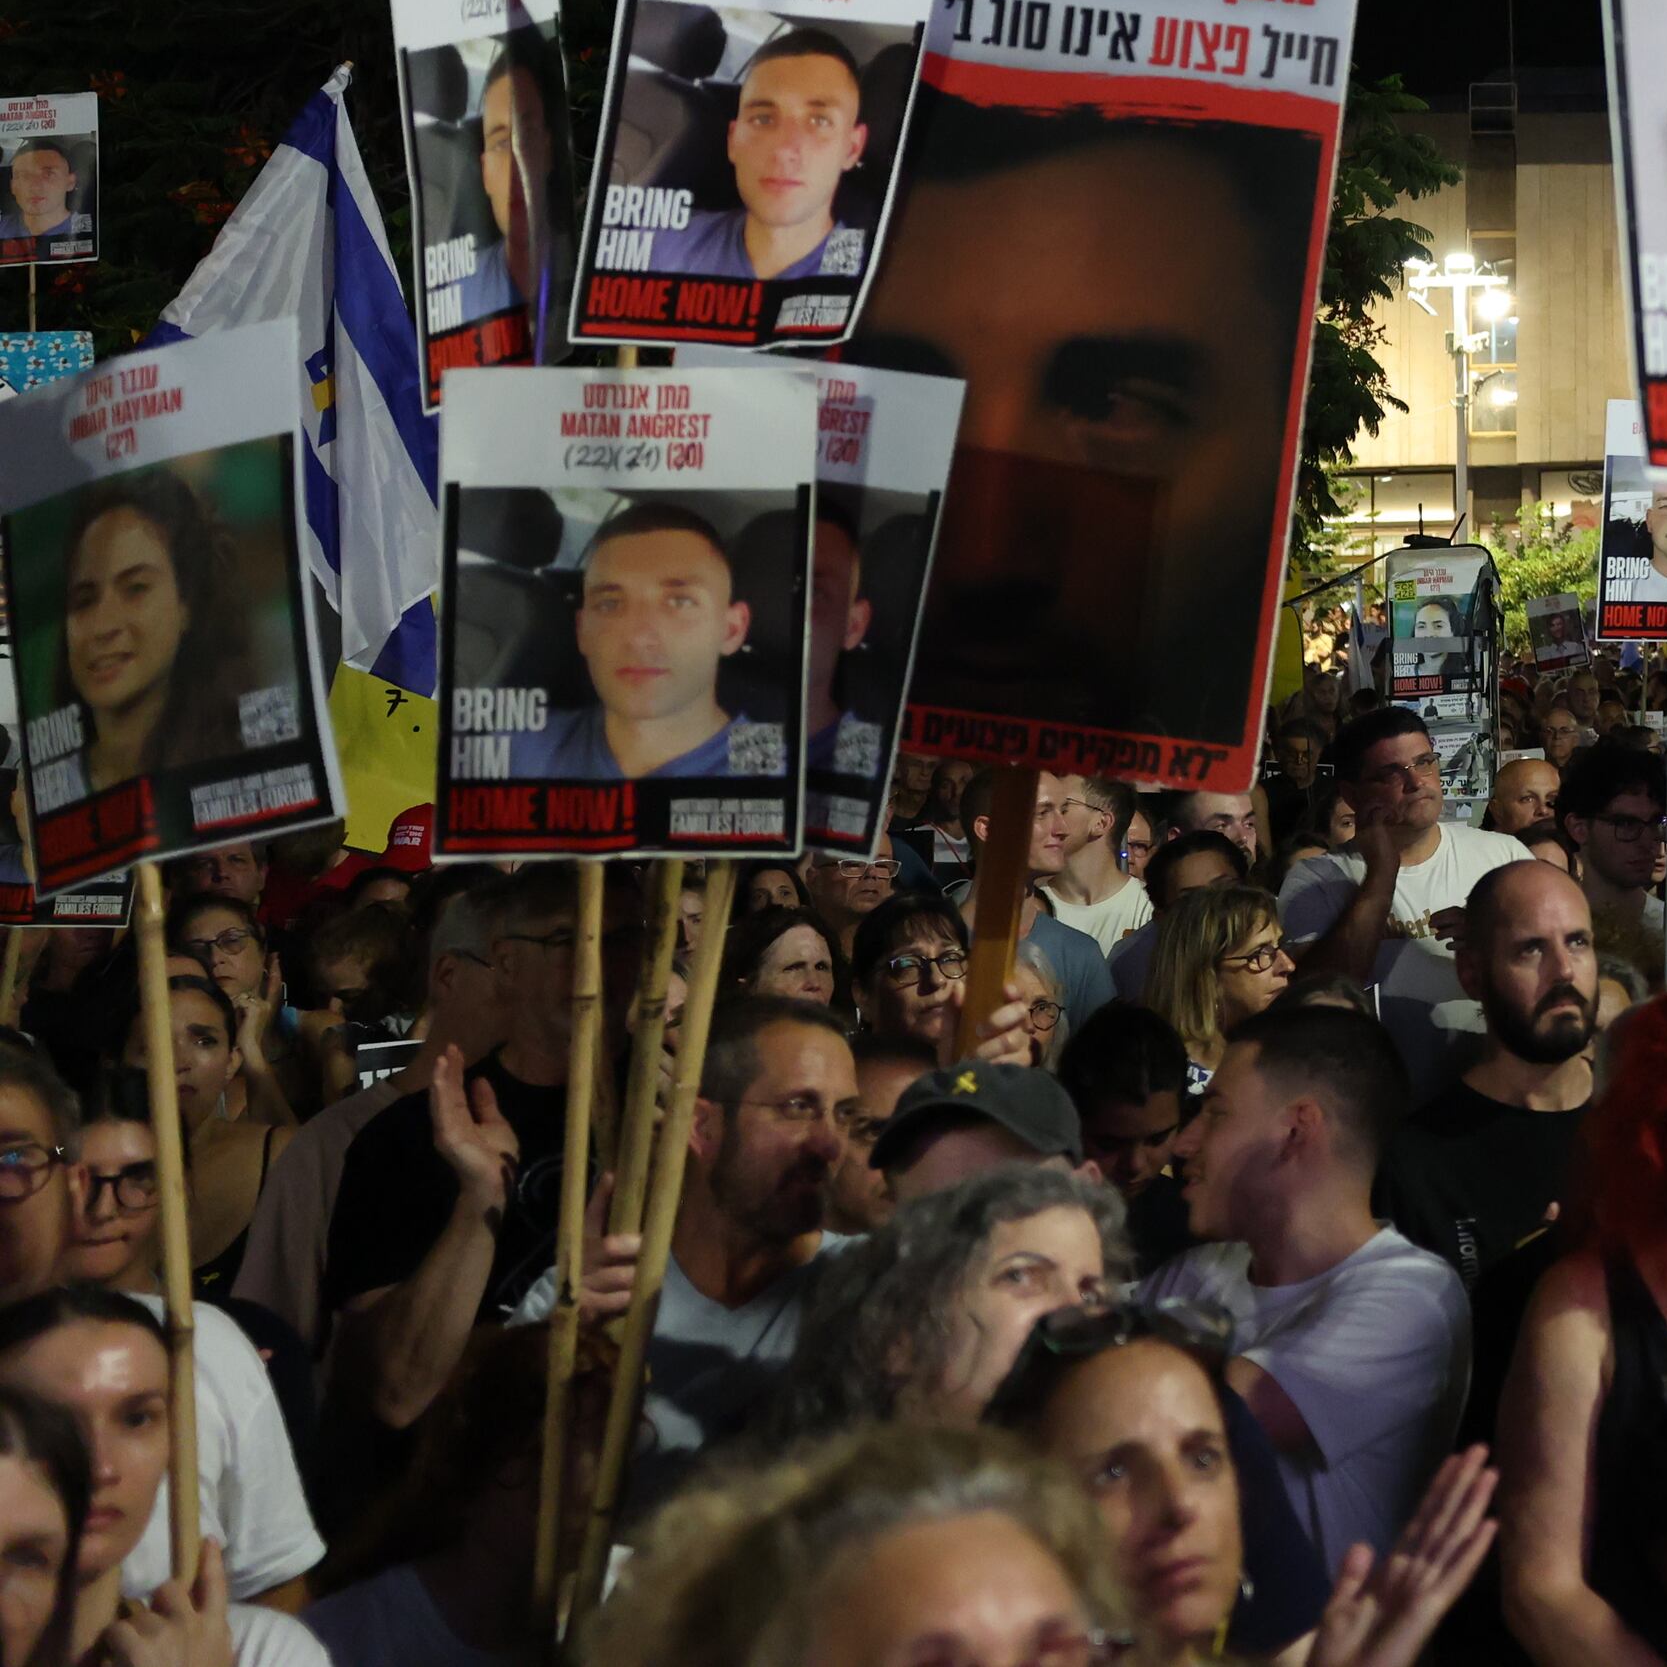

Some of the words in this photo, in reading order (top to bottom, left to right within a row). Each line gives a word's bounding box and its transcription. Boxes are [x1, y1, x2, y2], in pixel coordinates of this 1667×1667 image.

[1060, 5, 1141, 63] אינו
[1149, 15, 1250, 77] פצוע
[1261, 22, 1339, 87] חייל
[602, 184, 694, 230] BRING
[425, 234, 476, 286] BRING
[595, 231, 654, 272] HIM
[426, 284, 462, 335] HIM
[587, 276, 671, 319] HOME
[675, 278, 763, 328] NOW!
[561, 412, 621, 438] MATAN
[626, 414, 712, 440] ANGREST
[1606, 556, 1651, 579] BRING
[1605, 580, 1633, 602] HIM
[1604, 605, 1644, 627] HOME
[1419, 676, 1443, 690] NOW!
[452, 687, 548, 733] BRING
[450, 734, 511, 780] HIM
[449, 786, 538, 831] HOME
[546, 781, 637, 832] NOW!
